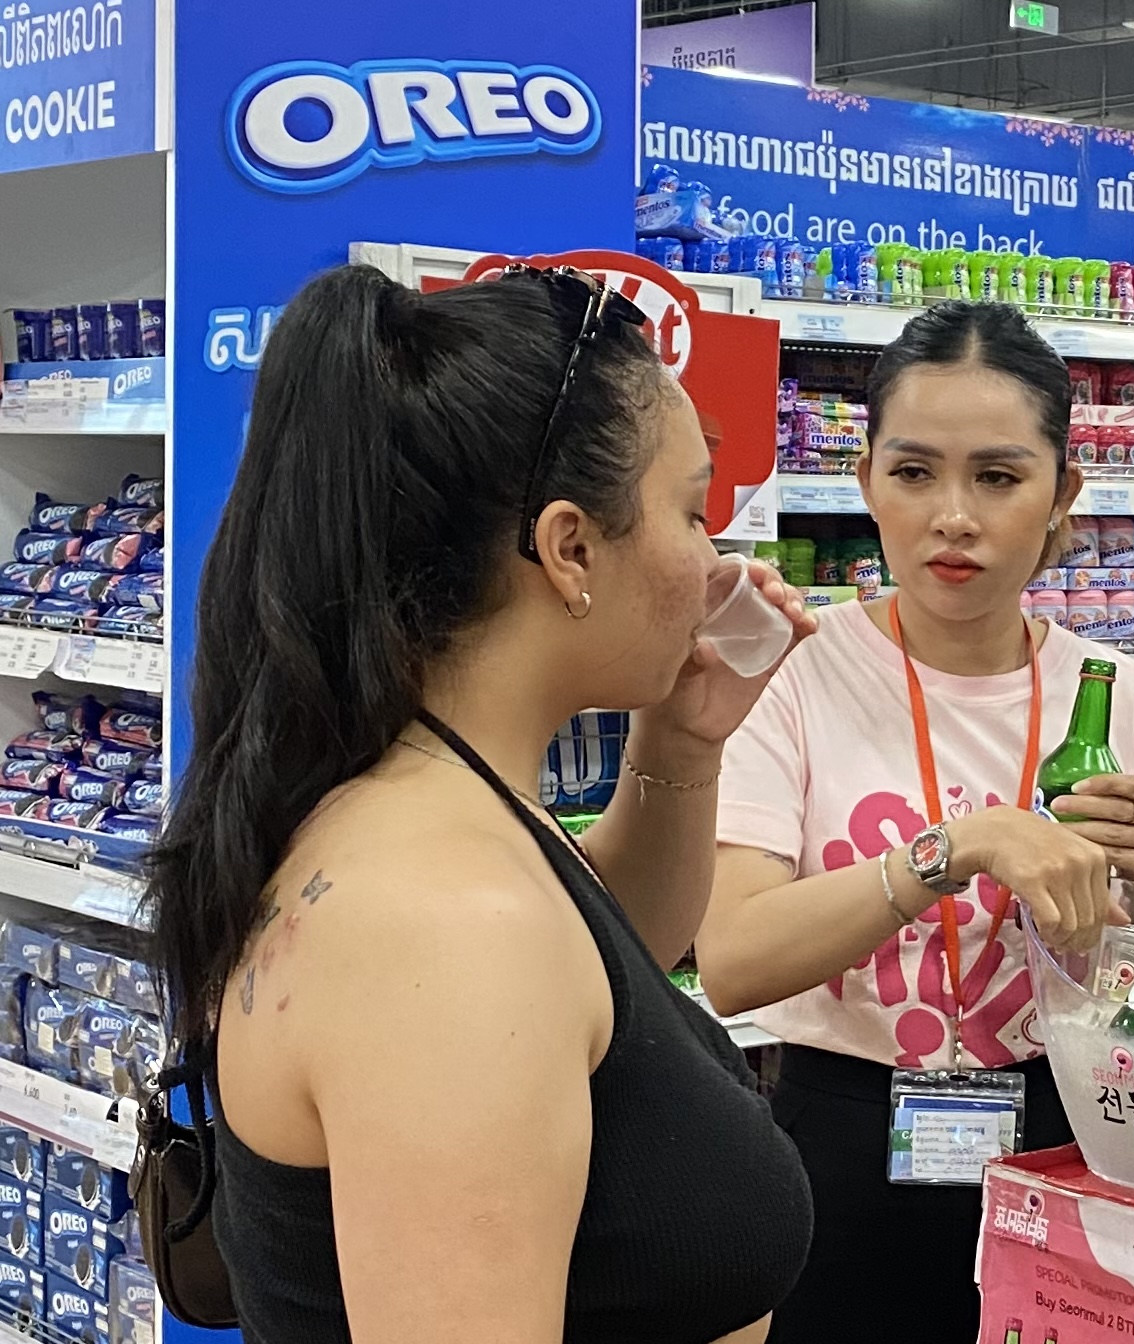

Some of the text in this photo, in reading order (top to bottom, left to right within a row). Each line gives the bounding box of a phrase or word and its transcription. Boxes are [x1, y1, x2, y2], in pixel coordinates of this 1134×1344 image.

[5, 80, 116, 144] COOKIE
[244, 71, 590, 170] OREO
[717, 196, 794, 240] food
[806, 215, 856, 243] are
[867, 221, 907, 245] on
[919, 219, 967, 251] the
[977, 223, 1045, 257] back
[113, 366, 152, 396] OREO
[810, 434, 862, 446] mentos
[22, 540, 57, 560] OREO
[96, 751, 132, 768] OREO
[71, 783, 103, 801] OREO
[90, 1015, 124, 1033] OREO
[50, 1211, 88, 1234] OREO
[1035, 1264, 1078, 1290] SPECIAL
[52, 1292, 90, 1316] OREO
[1035, 1291, 1056, 1313] Buy
[1059, 1298, 1106, 1326] Seonmul
[1107, 1314, 1115, 1329] 2
